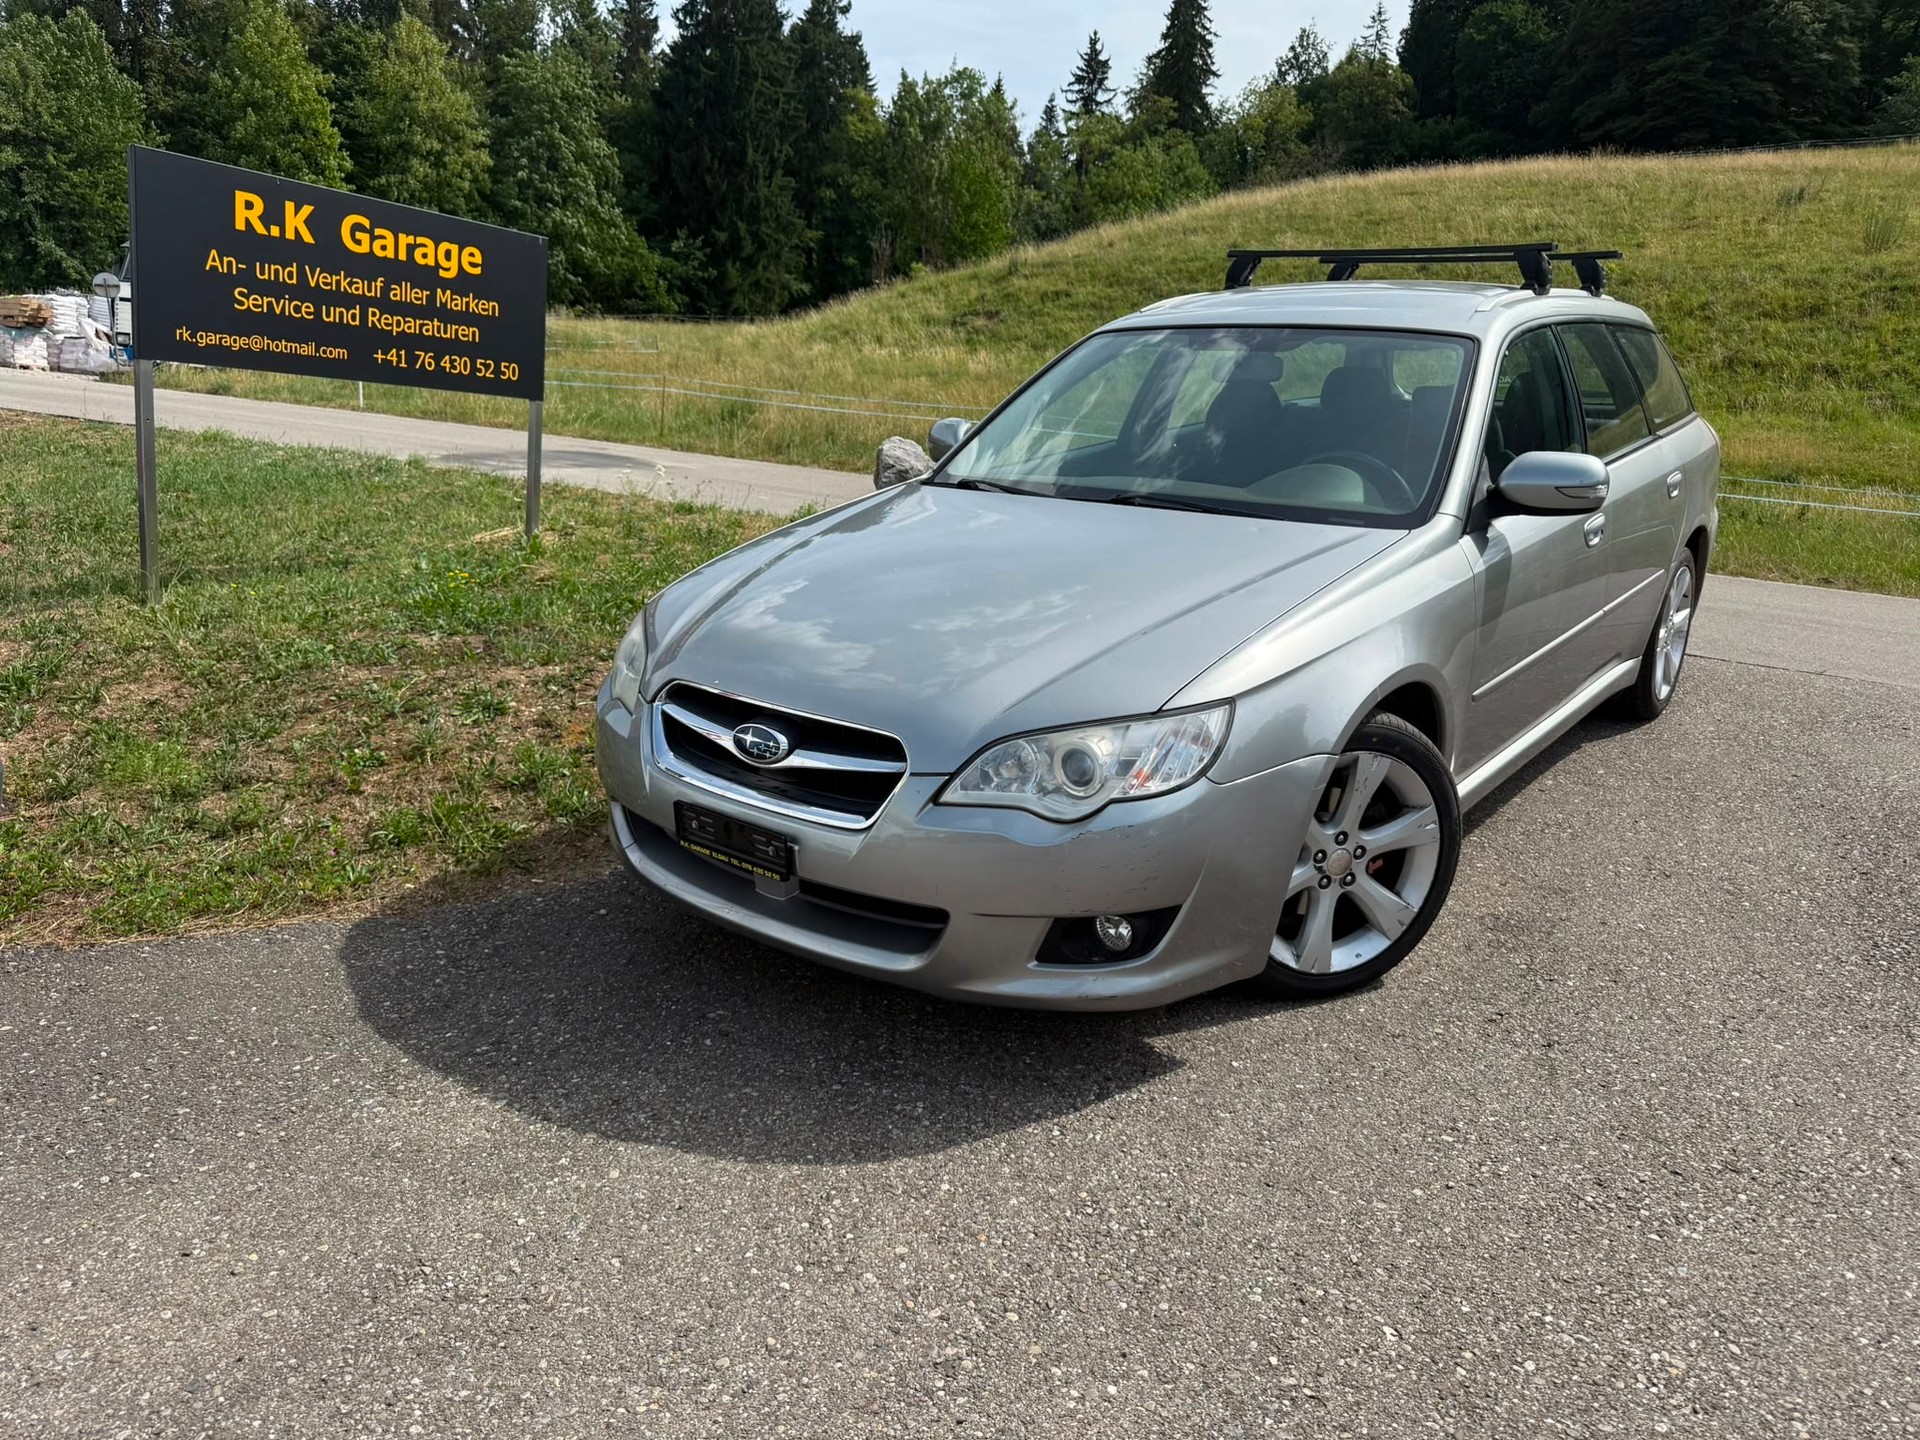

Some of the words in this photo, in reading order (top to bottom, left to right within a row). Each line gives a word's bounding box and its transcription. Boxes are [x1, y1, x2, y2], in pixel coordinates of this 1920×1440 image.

[234, 189, 316, 245] R.K
[340, 213, 483, 279] Garage
[205, 248, 247, 274] An-
[255, 261, 297, 286] und
[305, 266, 384, 299] Verkauf
[389, 279, 431, 305] aller
[436, 287, 499, 317] Marken
[233, 287, 315, 320] Service
[322, 304, 360, 327] und
[367, 308, 480, 343] Reparaturen
[175, 326, 348, 360] rk.garage@hotmail.com
[373, 349, 407, 369] +41
[415, 351, 436, 372] 76
[440, 355, 471, 376] 430
[476, 359, 495, 379] 52
[500, 362, 519, 382] 50
[690, 843, 711, 856] GARAGE
[764, 869, 772, 878] 52
[772, 873, 781, 881] 50
